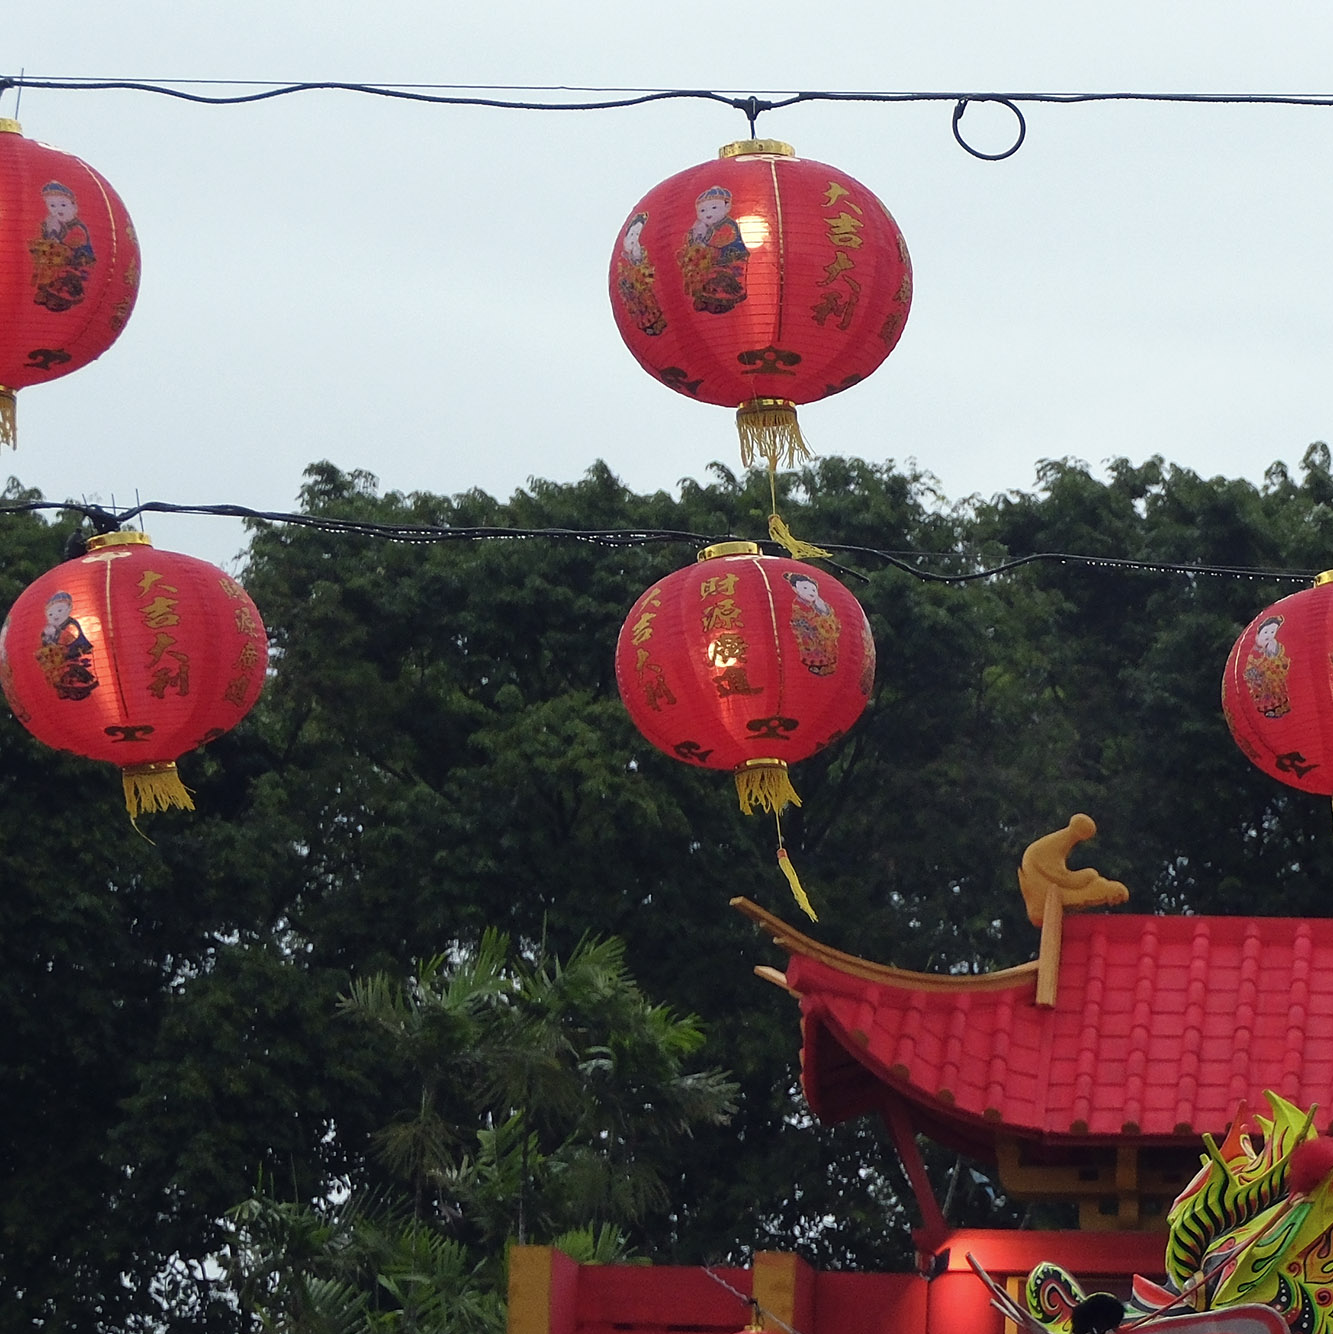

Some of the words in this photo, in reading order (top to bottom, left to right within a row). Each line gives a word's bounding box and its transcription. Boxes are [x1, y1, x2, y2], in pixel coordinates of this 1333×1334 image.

[810, 181, 864, 331] 大吉大利
[136, 570, 190, 699] 大吉大利
